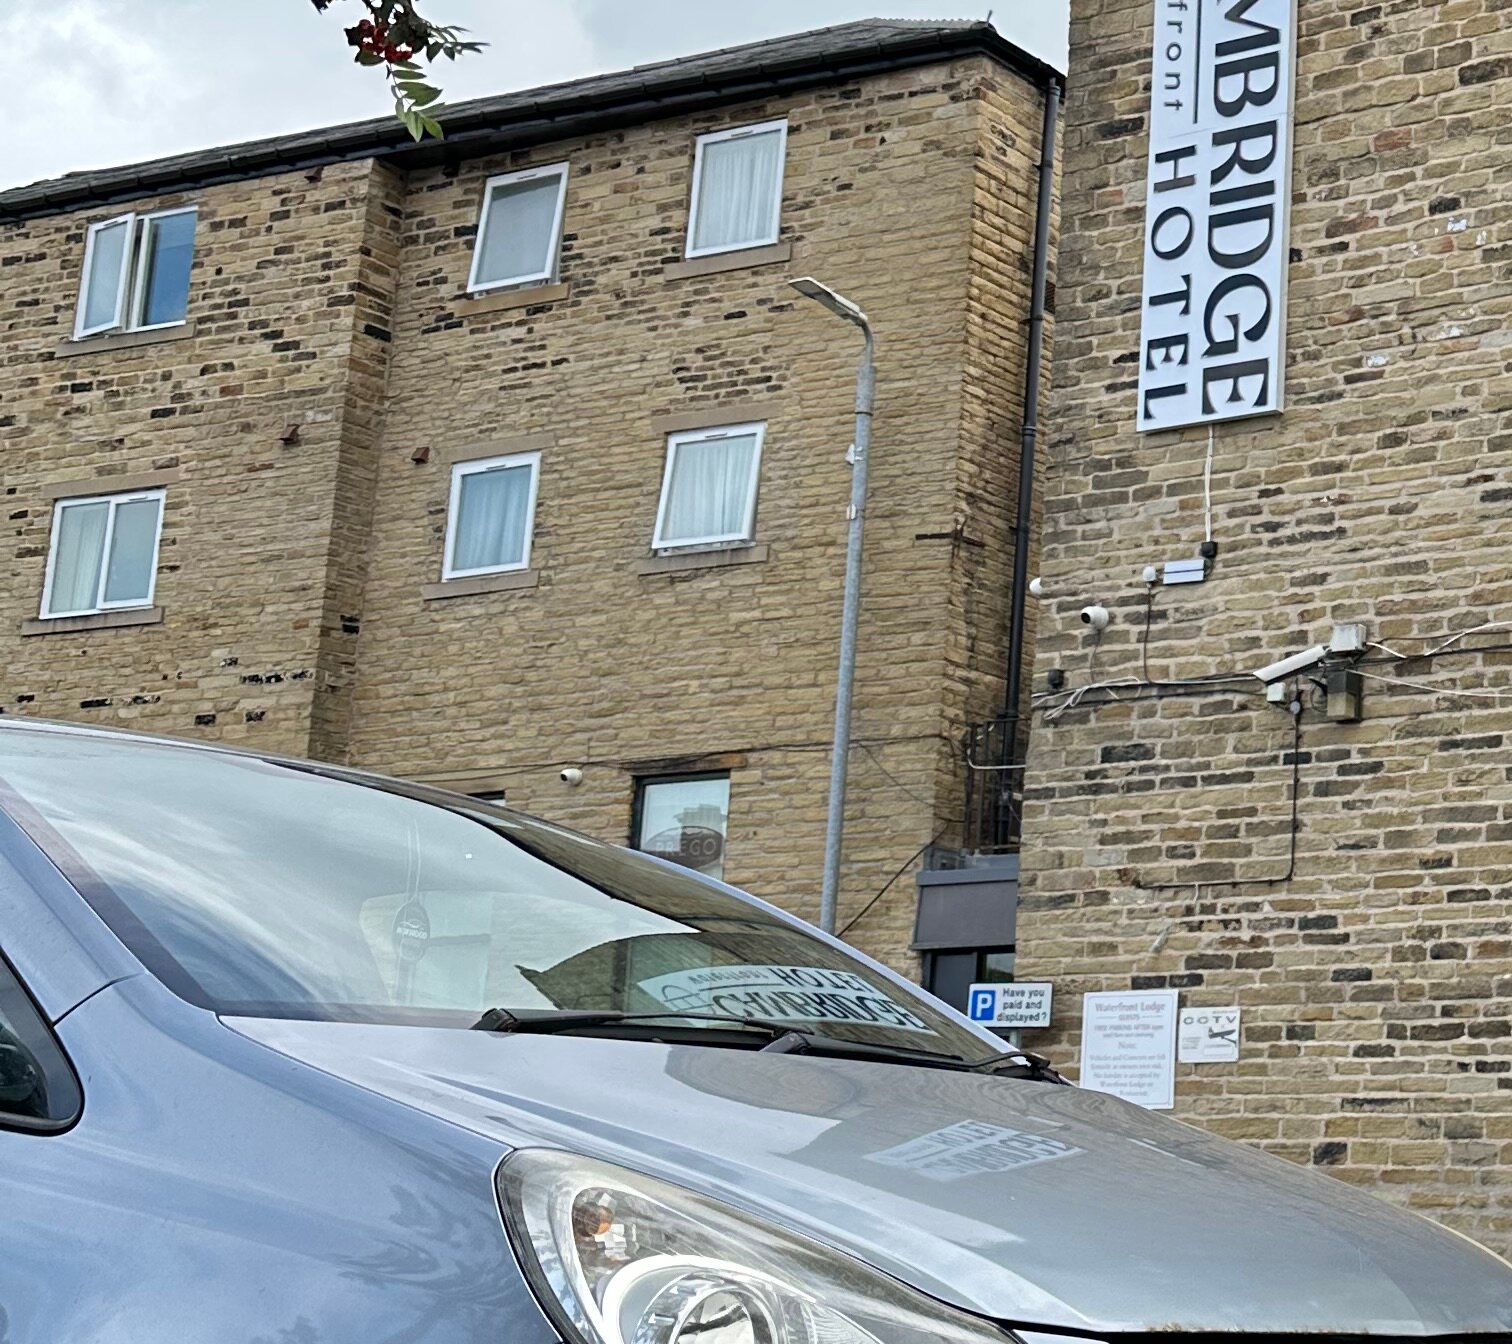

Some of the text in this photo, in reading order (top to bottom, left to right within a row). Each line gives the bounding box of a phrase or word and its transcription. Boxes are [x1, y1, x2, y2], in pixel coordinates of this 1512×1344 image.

[1143, 144, 1198, 420] HOTEL
[655, 838, 717, 858] PREGO
[1002, 987, 1045, 999] Have you
[976, 993, 993, 1018] P
[1002, 1000, 1043, 1010] paid and
[1183, 1015, 1237, 1025] CCTV
